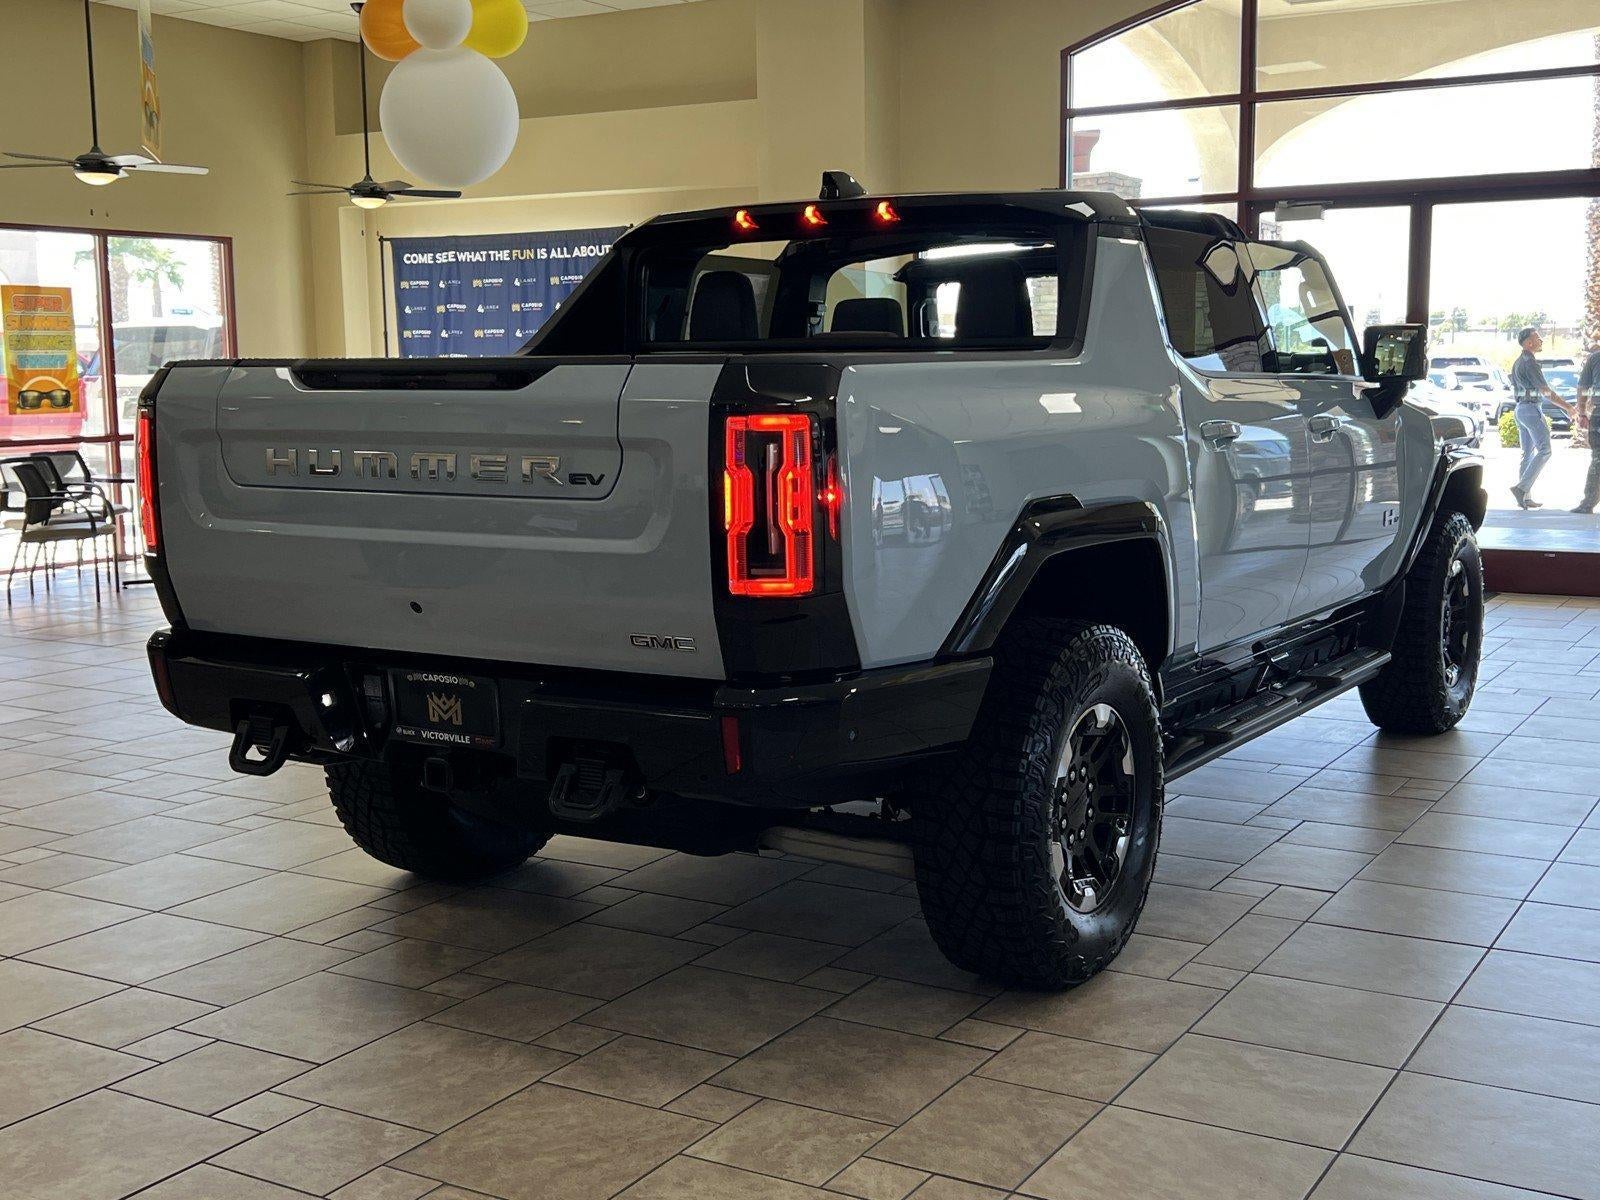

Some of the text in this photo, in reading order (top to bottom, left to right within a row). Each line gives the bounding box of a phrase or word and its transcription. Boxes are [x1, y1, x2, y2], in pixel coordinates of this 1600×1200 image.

[403, 244, 612, 264] COME SEE WHAT THE FUN IS ALL ABOUT
[6, 315, 73, 331] SUMMER
[265, 447, 605, 486] HUMMER EV
[629, 633, 697, 652] GMC
[422, 673, 459, 685] CAPOSIO
[421, 729, 471, 744] VICTORVILLE
